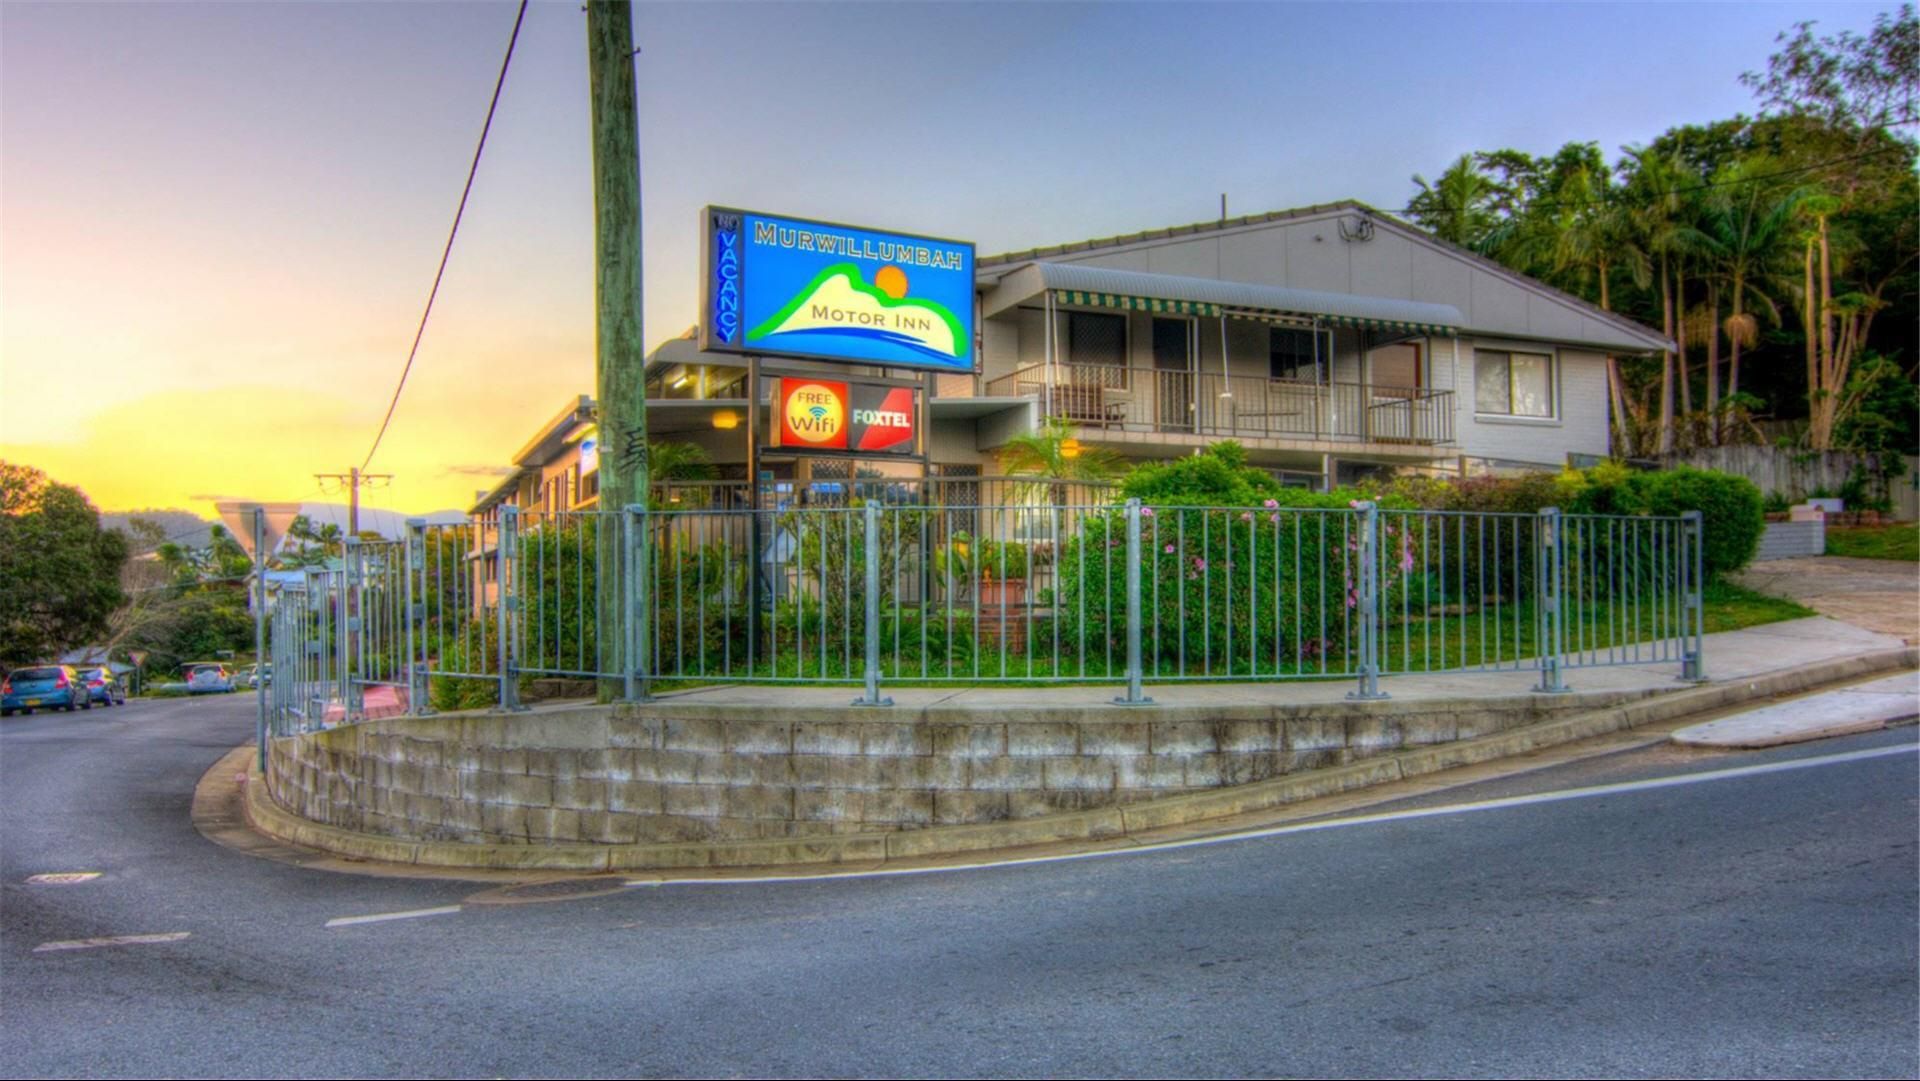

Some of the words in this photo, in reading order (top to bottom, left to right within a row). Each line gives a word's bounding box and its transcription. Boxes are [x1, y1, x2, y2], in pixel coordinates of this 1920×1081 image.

[754, 221, 963, 271] MURWILLUMBAH
[720, 231, 739, 343] VACANCY
[811, 304, 886, 328] MOTOR
[895, 314, 931, 331] INN
[796, 392, 832, 405] FREE
[790, 415, 835, 433] Wifi
[852, 408, 911, 428] FOXTEL
